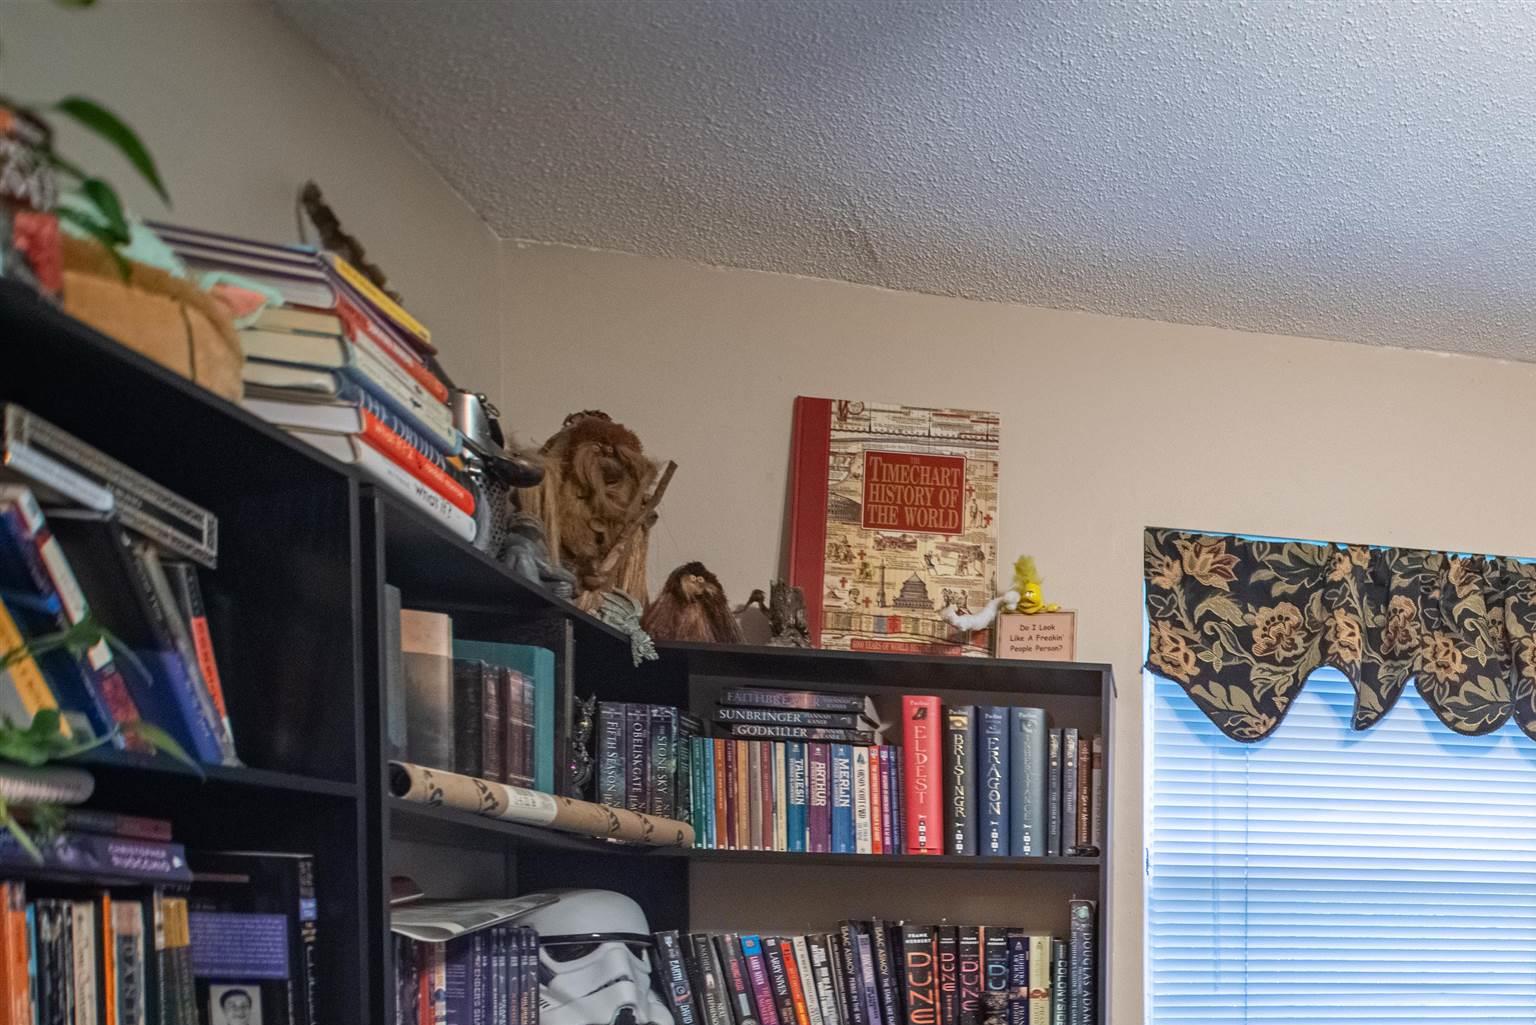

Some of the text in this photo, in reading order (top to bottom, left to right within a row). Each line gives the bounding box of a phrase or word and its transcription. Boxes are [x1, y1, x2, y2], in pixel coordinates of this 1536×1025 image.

[869, 456, 961, 488] TIMECHART
[868, 483, 959, 509] HISTORY OF
[867, 503, 960, 529] THE WORLD
[1009, 634, 1025, 642] Like
[1035, 633, 1065, 642] Freakin'
[1019, 624, 1030, 632] Do
[1009, 644, 1063, 653] People Person?
[719, 709, 802, 723] SUNBRINGER
[737, 724, 809, 738] GODKILLER
[606, 721, 619, 792] FIFTH SEASON
[630, 722, 643, 793] OBELISK GATE
[656, 735, 668, 794] STONE SKY
[912, 725, 928, 803] ELDEST
[795, 759, 806, 806] TALIESIN
[815, 762, 828, 807] ARTHUR
[839, 757, 851, 808] MERLIN
[953, 733, 967, 818] BRISINGR
[986, 736, 1001, 815] ERAGON
[840, 926, 849, 946] ISAAC
[874, 927, 884, 947] ISAAC
[669, 959, 683, 983] EARTH
[699, 943, 712, 972] ANATHEM
[843, 948, 854, 975] ASIMOV
[876, 949, 887, 976] ASIMOV
[1082, 931, 1092, 986] DOUGLAS
[769, 951, 787, 996] LARRY NIVEN
[679, 1004, 694, 1024] DAVID
[717, 1002, 728, 1018] NEAL
